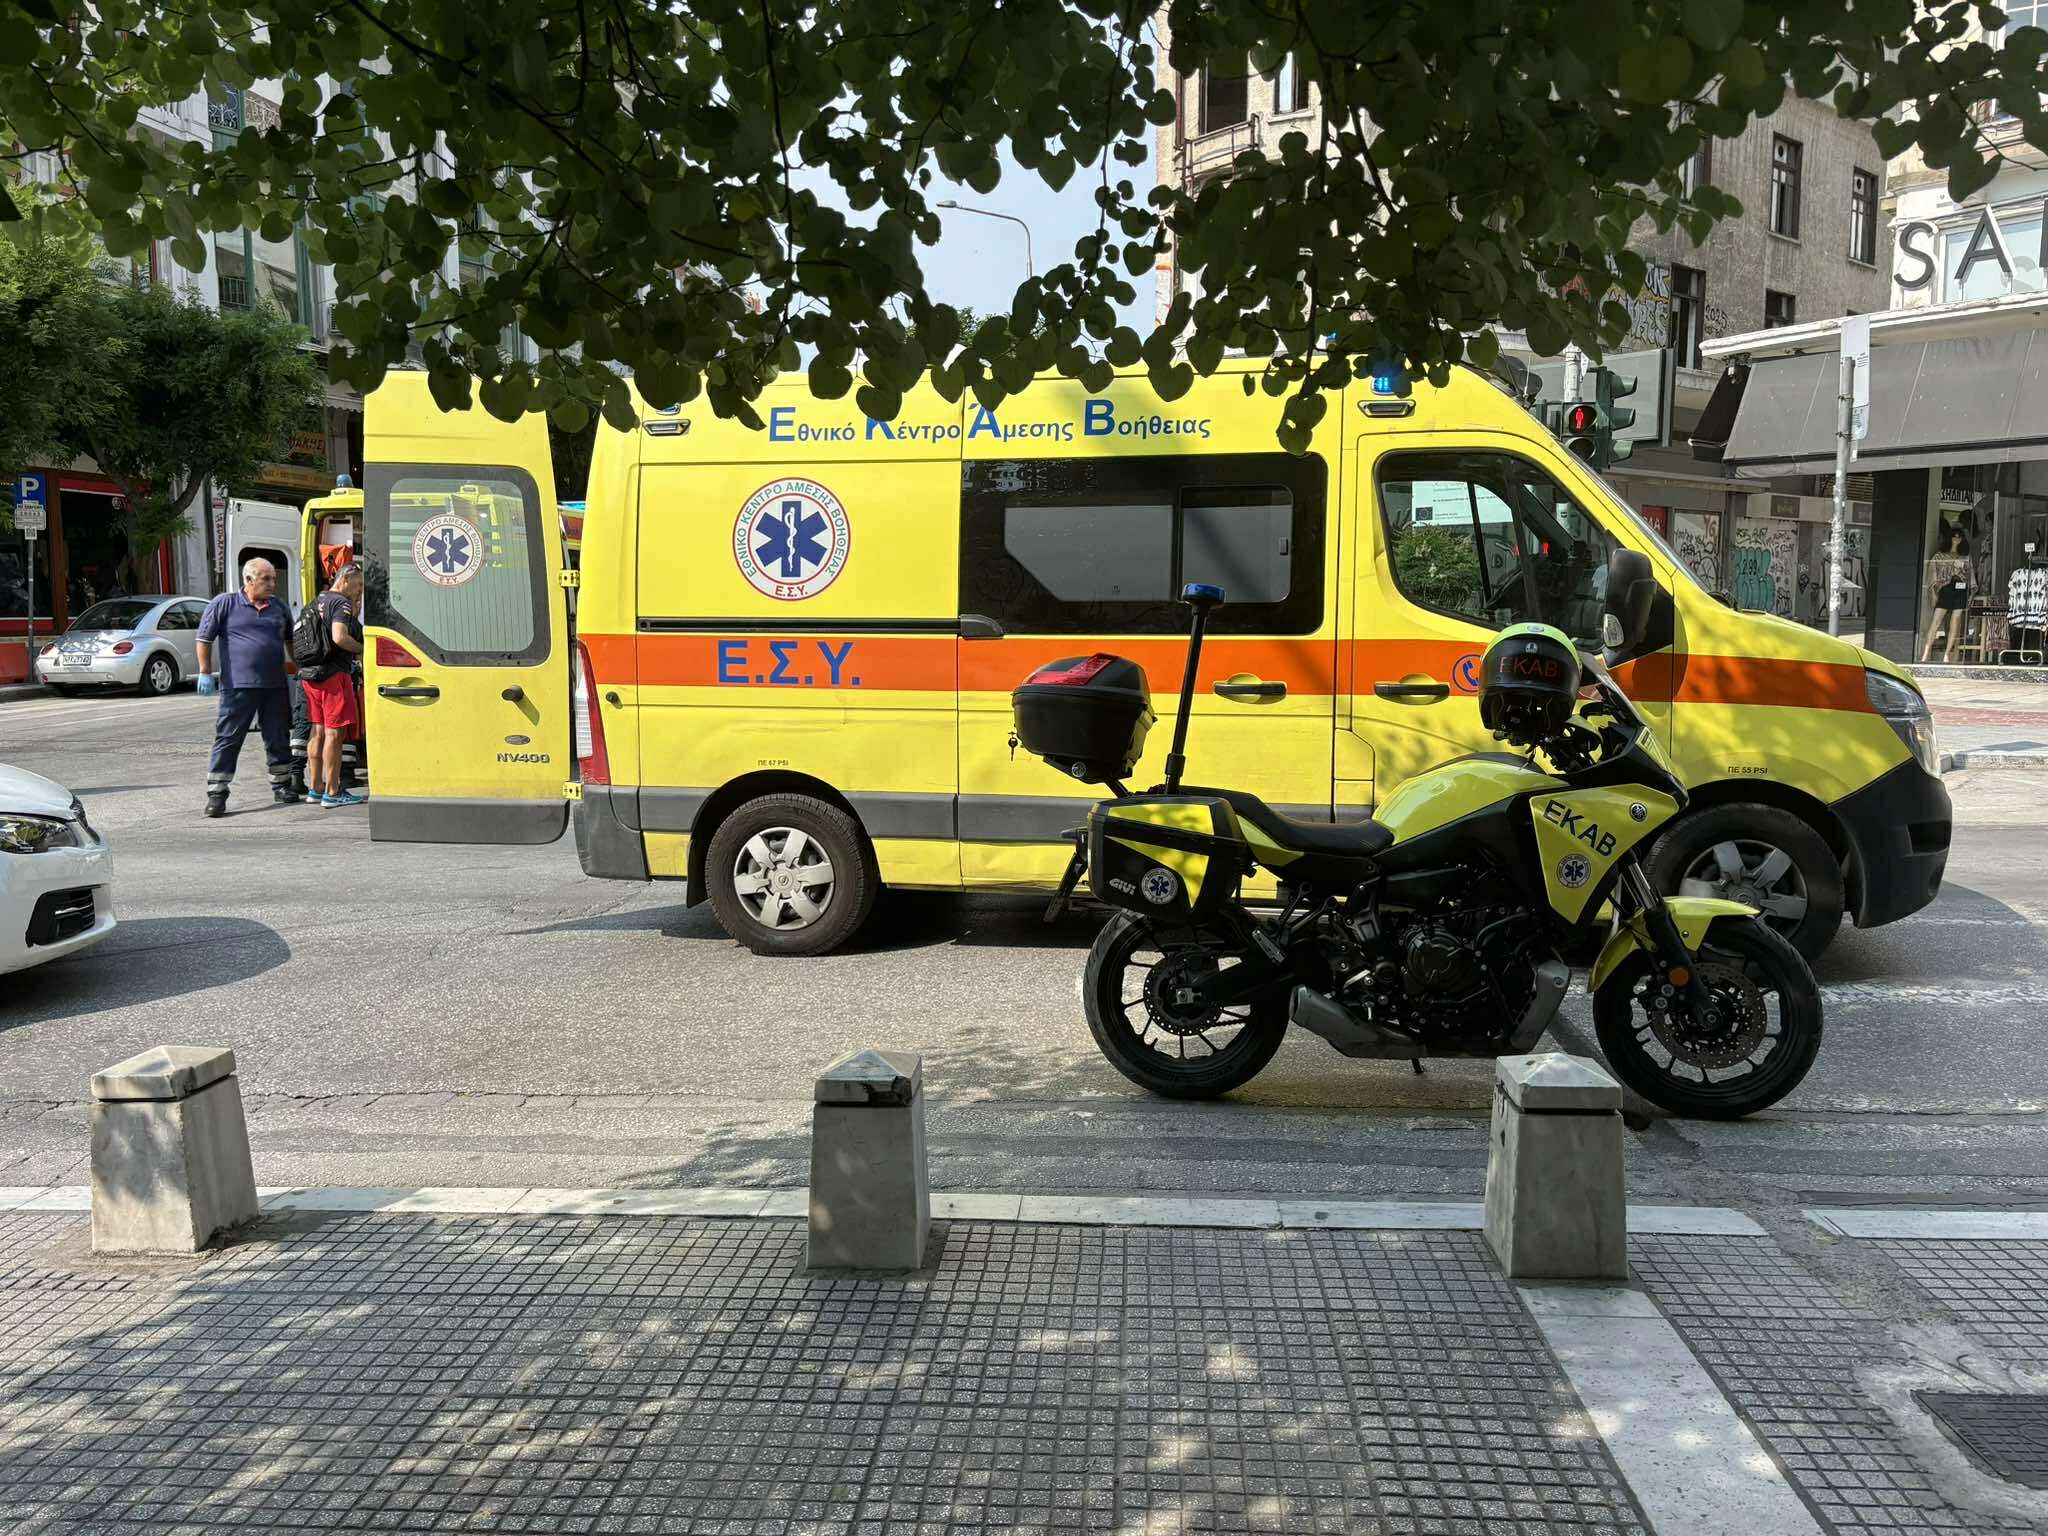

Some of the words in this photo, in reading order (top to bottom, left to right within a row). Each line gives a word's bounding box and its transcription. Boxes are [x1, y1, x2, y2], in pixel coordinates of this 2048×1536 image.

[1894, 203, 2048, 289] SA
[769, 406, 855, 442] Εθνικό
[968, 403, 1073, 442] Άμεσης
[1084, 399, 1211, 440] Βοήθειας
[21, 477, 39, 497] P
[741, 484, 782, 525] ΚΕΝΤΡΟ
[785, 482, 834, 508] ΑΜΕΣΗΣ
[736, 528, 757, 577] ΕΘΝΙΚΟ
[825, 508, 847, 577] ΒΟΗΘΕΙΑΣ
[775, 585, 808, 597] Ε.Σ.Υ.
[718, 640, 861, 685] Ε.Σ.Υ.
[1500, 656, 1558, 677] ΕΚΑΒ
[496, 752, 550, 763] NV400
[1543, 799, 1617, 857] ΕΚΑΒ
